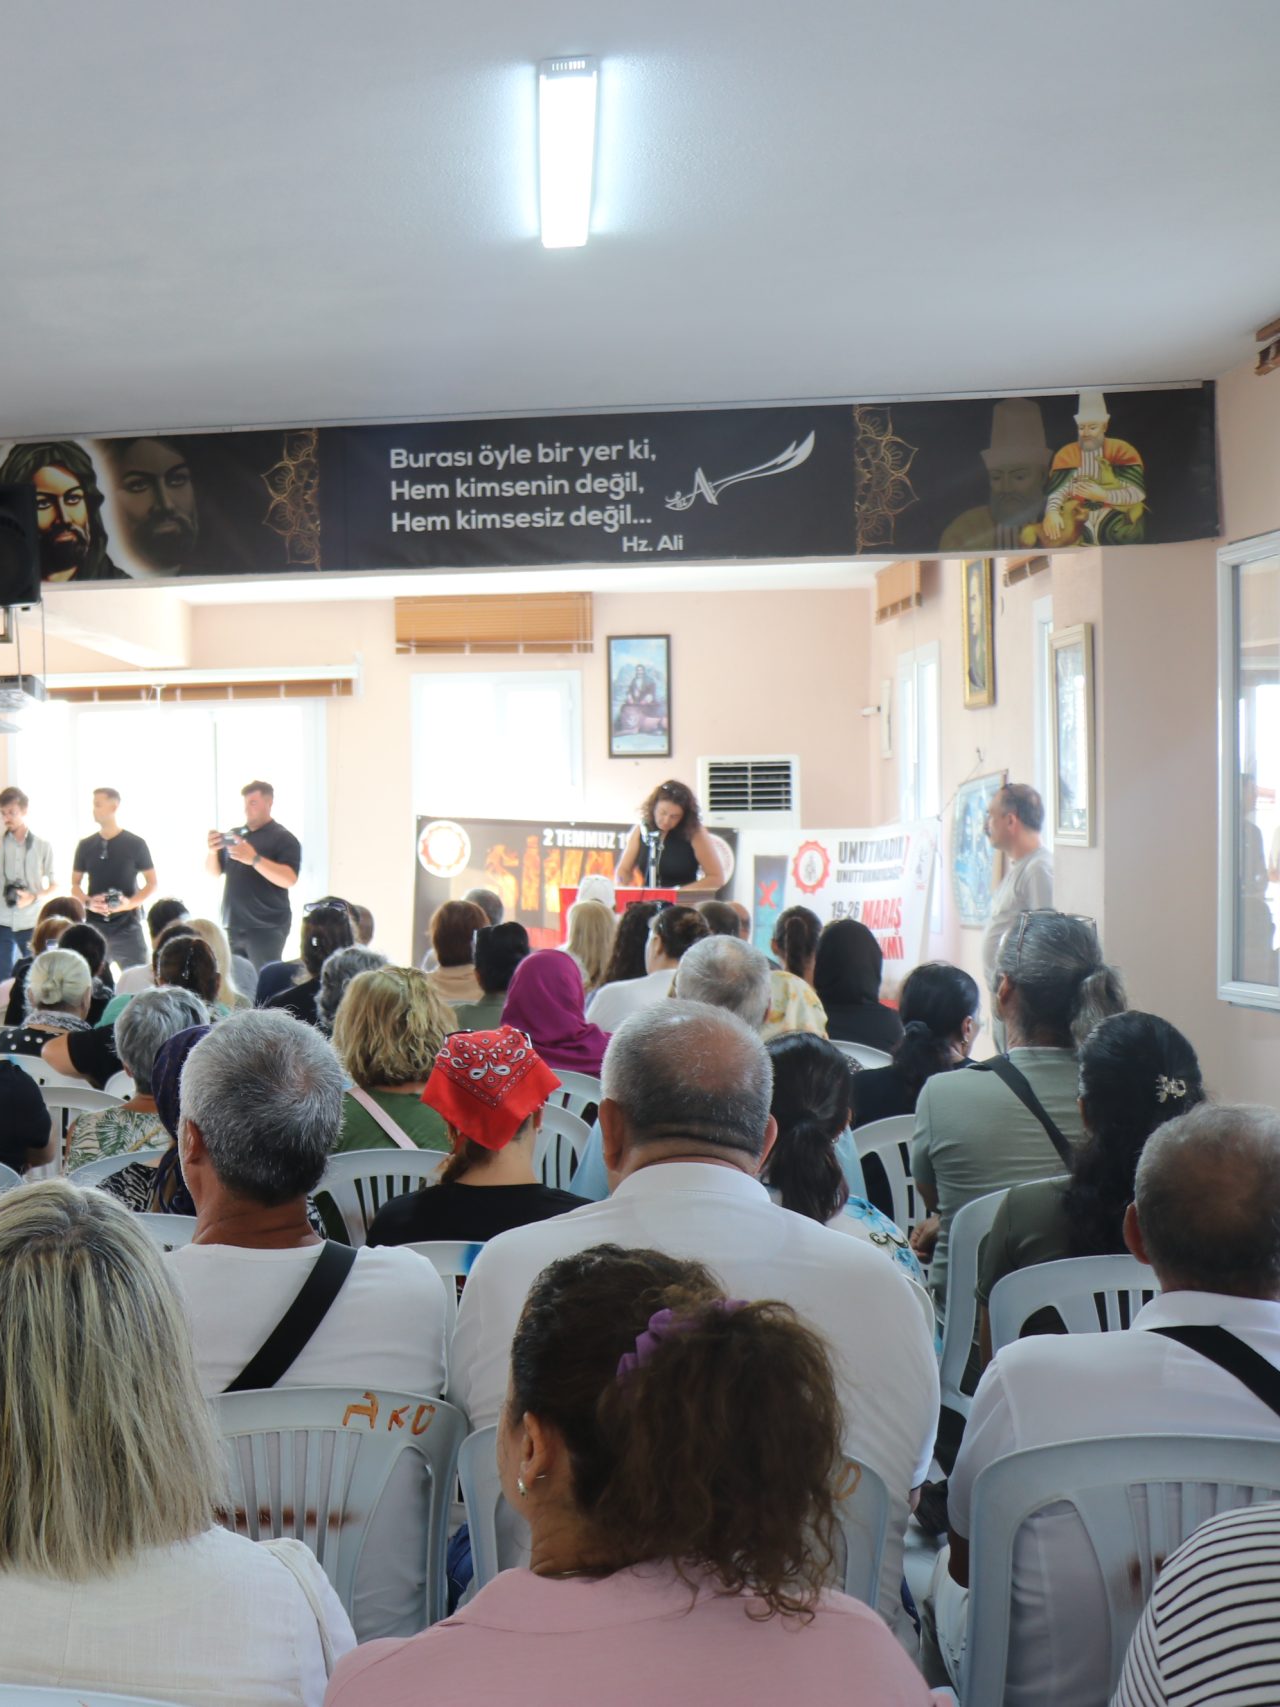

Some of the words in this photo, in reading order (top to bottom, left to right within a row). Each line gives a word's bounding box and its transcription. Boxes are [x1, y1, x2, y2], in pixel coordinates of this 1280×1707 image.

[390, 449, 472, 469] Burası
[478, 444, 531, 471] öyle
[538, 442, 573, 464] bir
[579, 445, 623, 467] yer
[629, 439, 656, 462] ki,
[391, 480, 449, 500] Hem
[456, 474, 569, 499] kimsenin
[575, 472, 644, 500] değil,
[392, 512, 450, 532] Hem
[457, 507, 564, 530] kimsesiz
[570, 504, 652, 533] değil...
[622, 536, 653, 552] Hz.
[657, 535, 684, 551] Ali
[543, 828, 554, 846] 2
[556, 829, 616, 849] TEMMUZ
[831, 901, 860, 920] 19-26
[861, 897, 902, 936] MARAŞ
